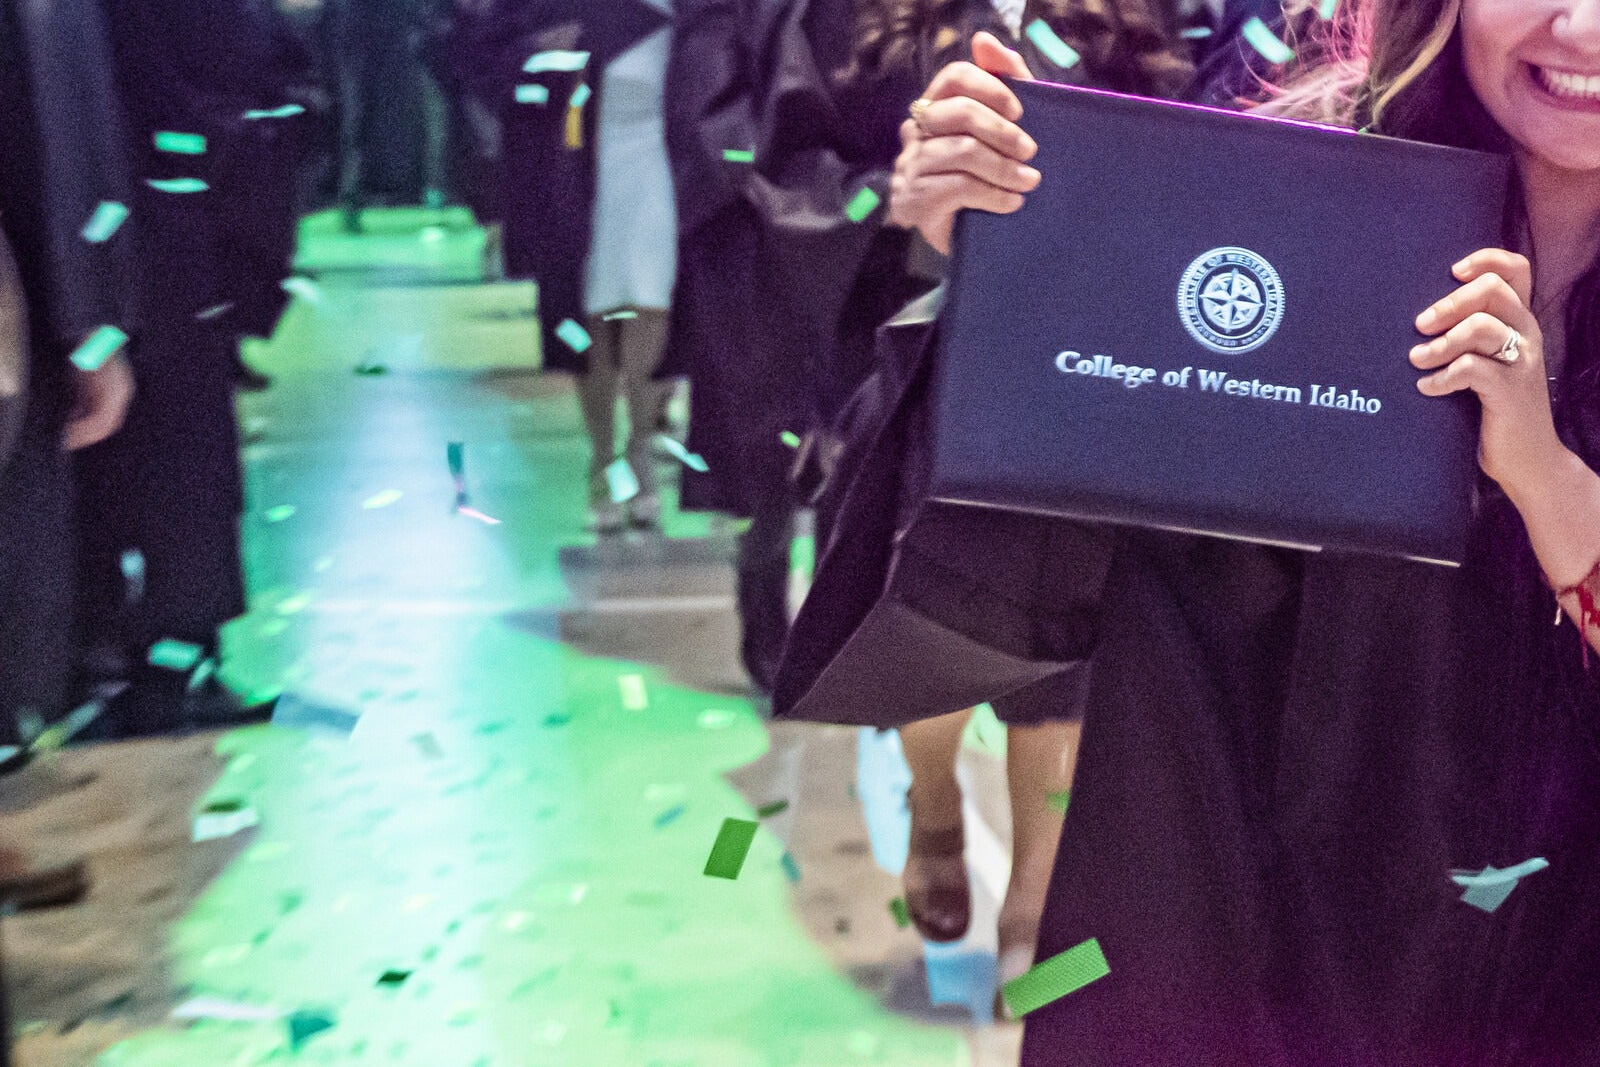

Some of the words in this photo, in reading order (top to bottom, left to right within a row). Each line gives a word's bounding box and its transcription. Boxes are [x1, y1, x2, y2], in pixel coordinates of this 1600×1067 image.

[1055, 350, 1157, 388] College
[1162, 366, 1193, 388] of
[1197, 369, 1302, 403] Western
[1308, 384, 1382, 414] Idaho
